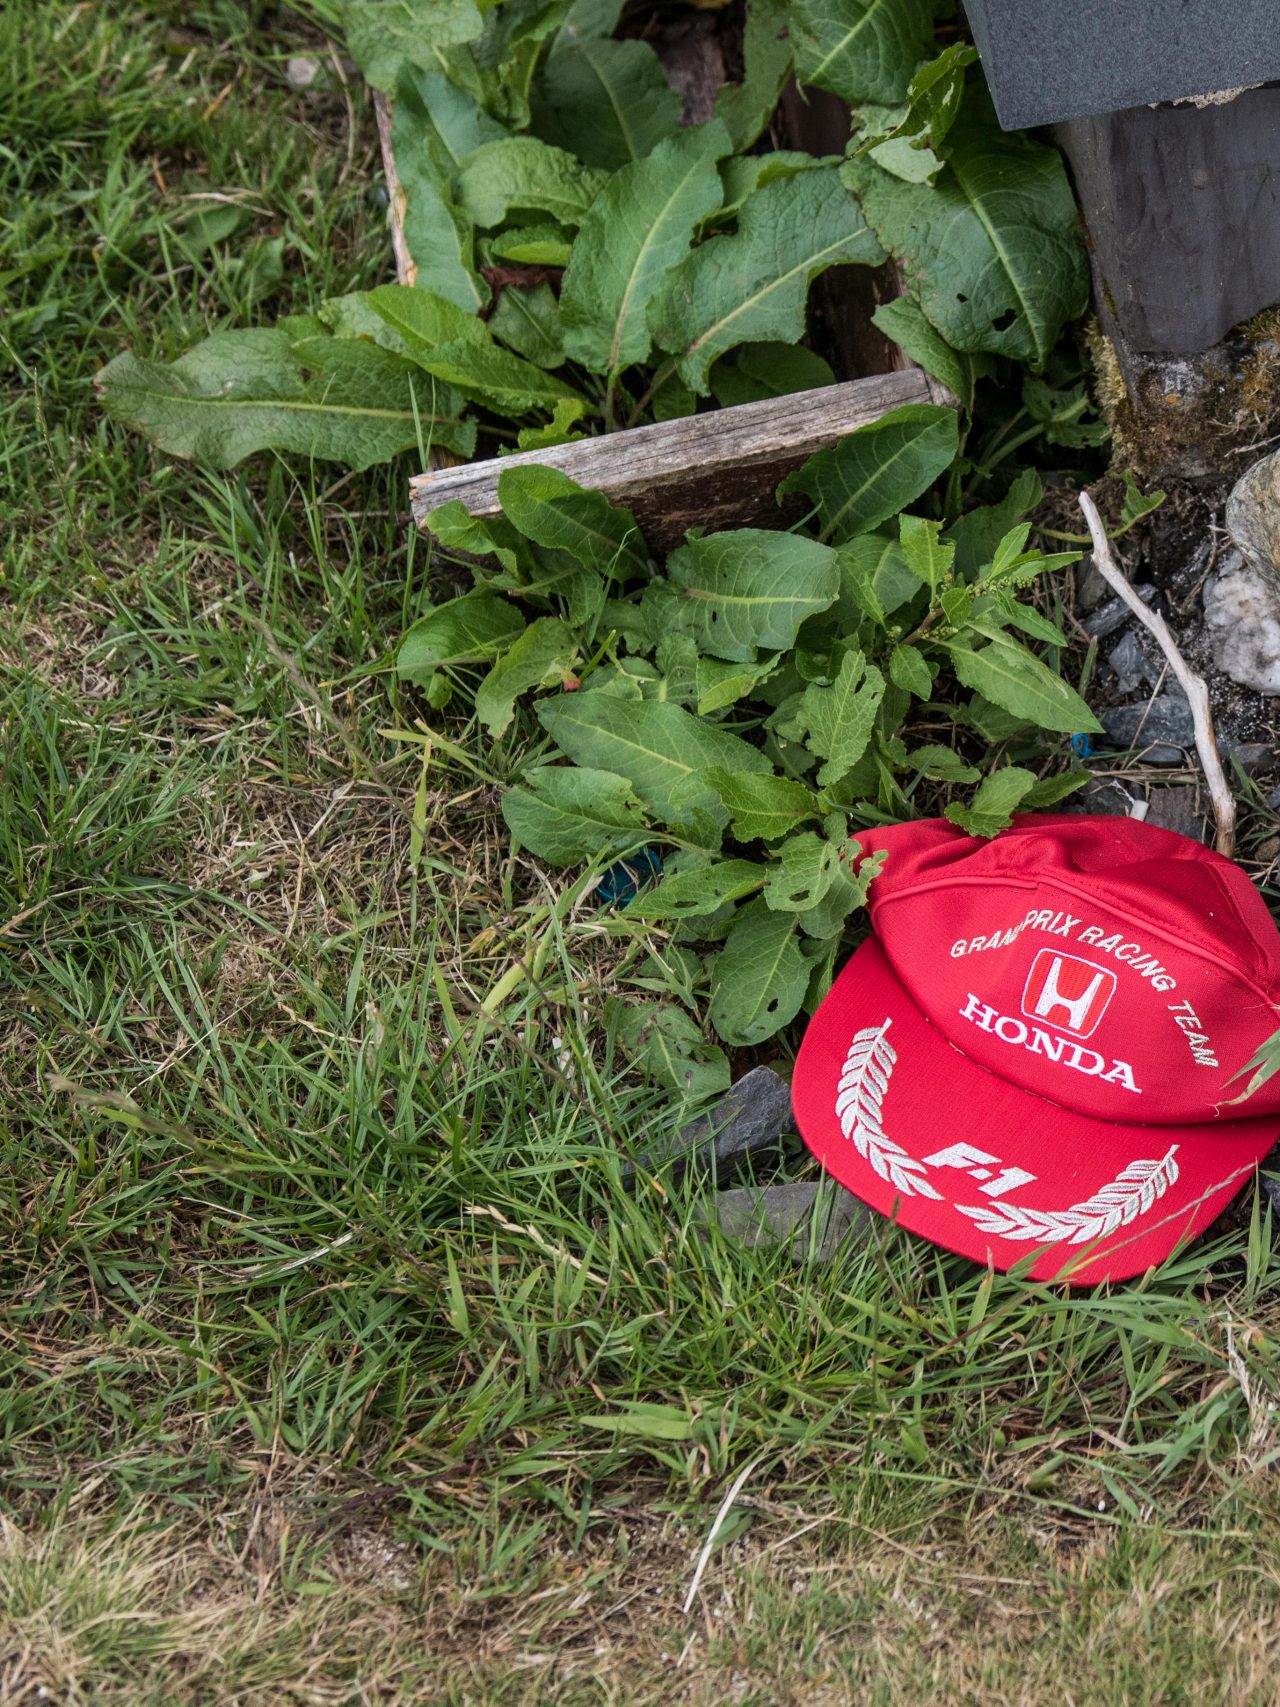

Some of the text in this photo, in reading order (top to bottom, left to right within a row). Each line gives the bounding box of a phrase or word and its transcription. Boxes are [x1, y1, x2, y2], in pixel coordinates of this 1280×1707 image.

[958, 992, 1142, 1094] HONDA
[1020, 909, 1082, 937] PRIX
[1077, 925, 1177, 993] RACING
[1168, 999, 1219, 1068] TEAM
